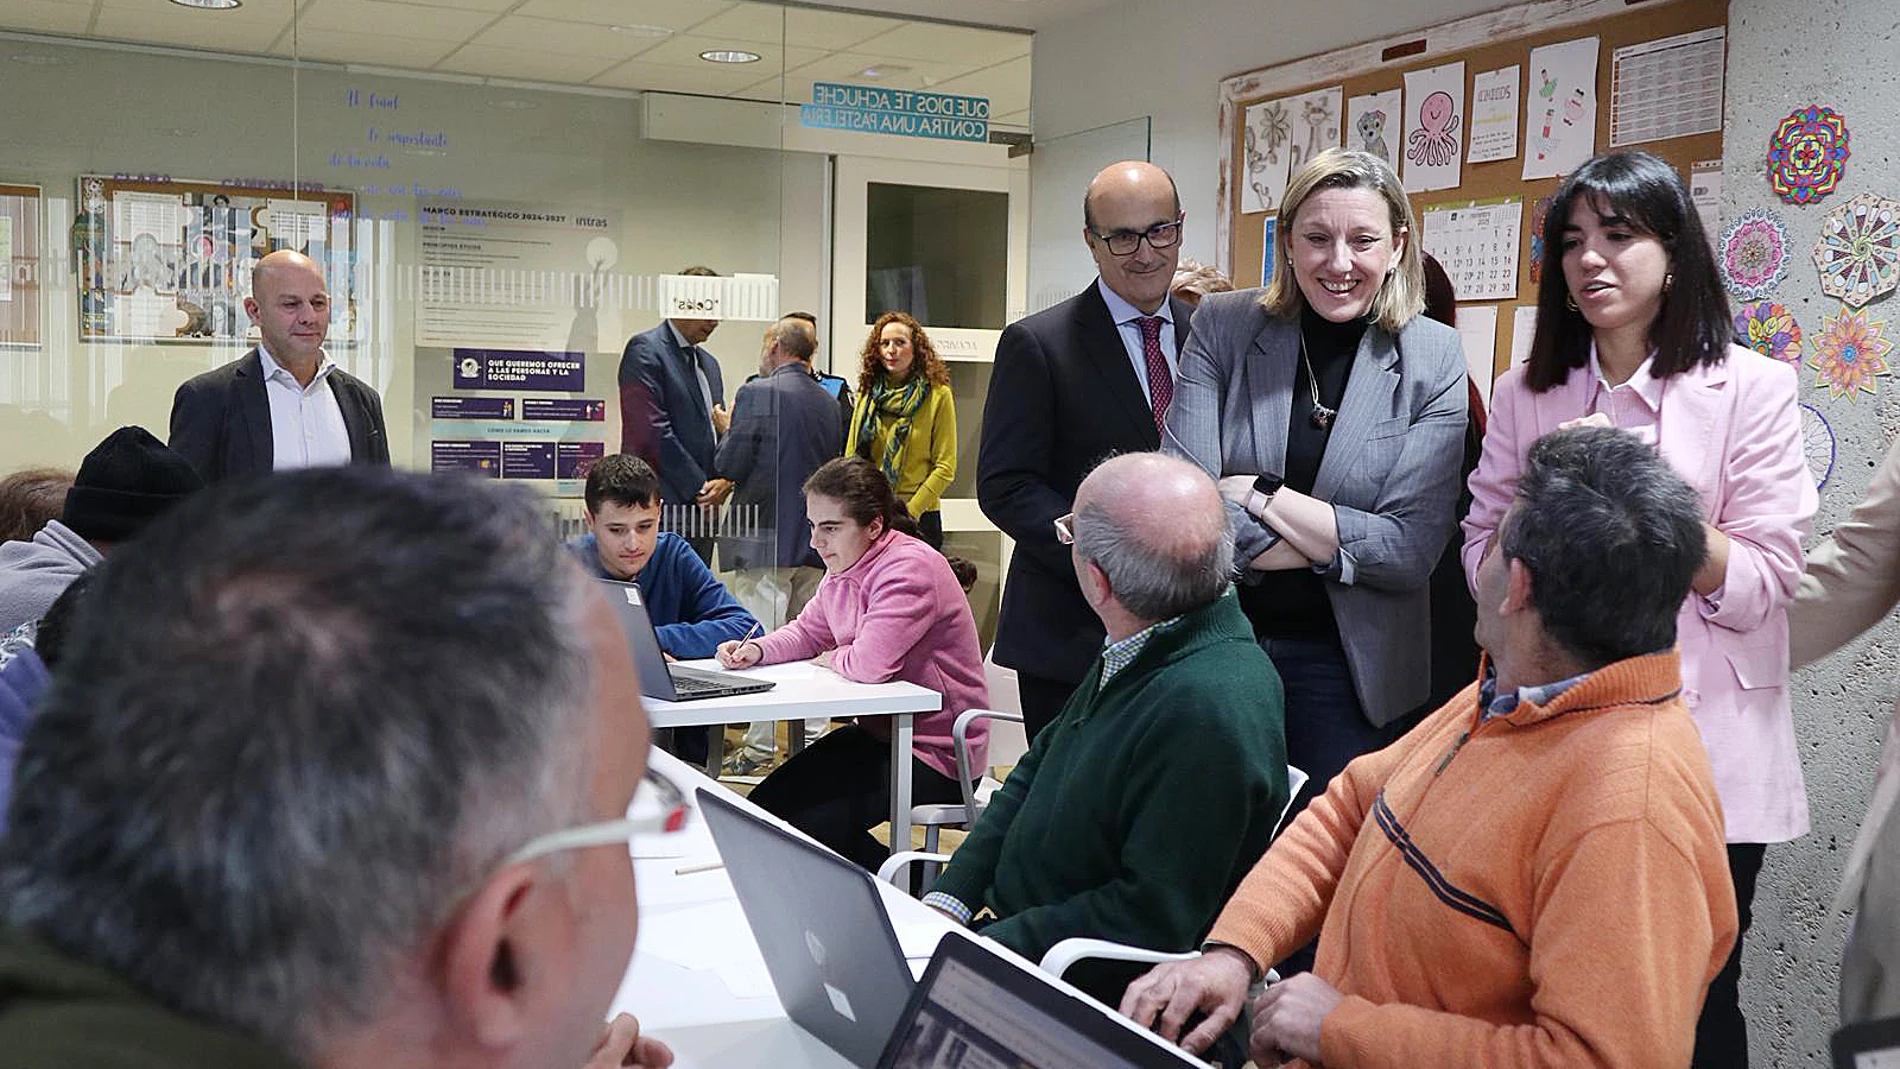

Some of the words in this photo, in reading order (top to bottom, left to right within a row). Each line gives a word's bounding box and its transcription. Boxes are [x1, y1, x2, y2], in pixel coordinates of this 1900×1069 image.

[423, 206, 457, 217] MARCO
[521, 212, 566, 223] 2024-2027
[575, 215, 608, 229] intras
[505, 360, 546, 369] QUEREMOS
[547, 361, 581, 370] OFRECER
[496, 366, 510, 374] LAS
[511, 367, 551, 375] PERSONAS
[559, 368, 569, 376] LA
[487, 373, 526, 381] SOCIEDAD
